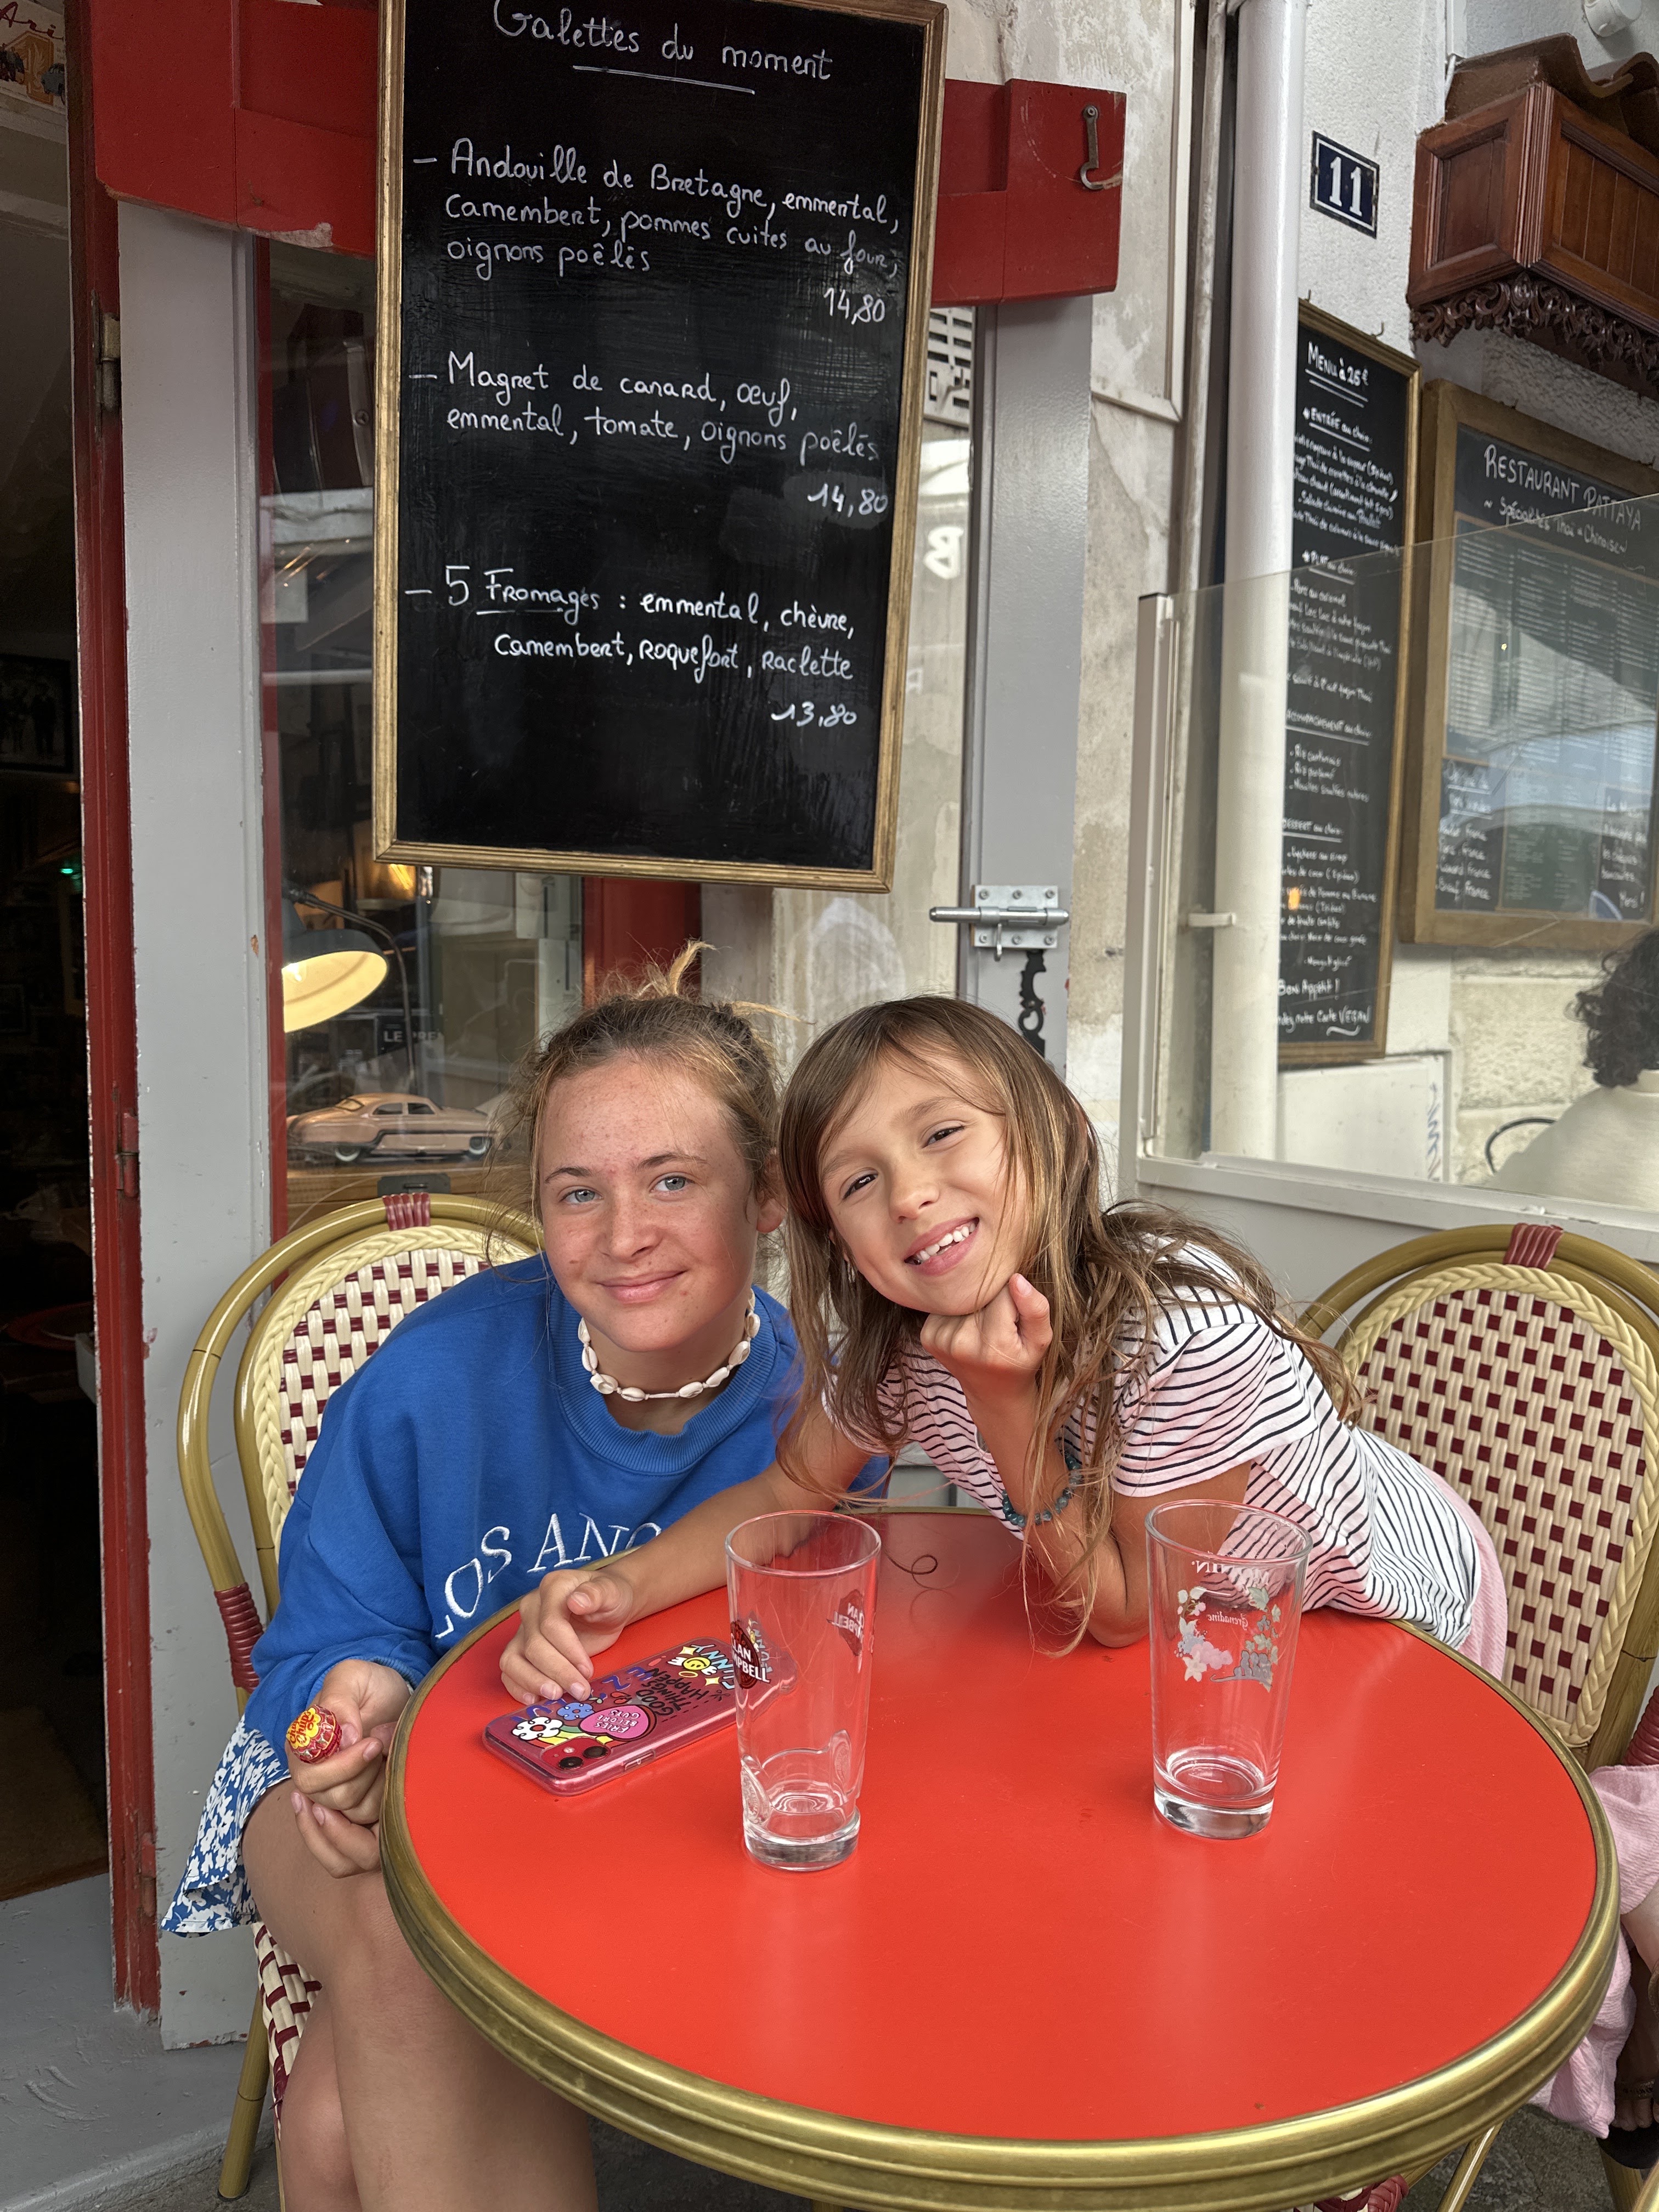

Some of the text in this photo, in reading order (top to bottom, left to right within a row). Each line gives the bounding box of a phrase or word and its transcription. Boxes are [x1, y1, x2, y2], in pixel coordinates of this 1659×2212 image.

[494, 0, 833, 80] Galettes du moment
[452, 138, 587, 183] Andouille
[603, 159, 633, 188] de
[782, 193, 898, 237] emmental,
[1330, 157, 1362, 217] 11
[445, 194, 610, 237] Camembert,
[617, 211, 710, 246] pommes
[726, 216, 787, 249] cuites
[804, 238, 831, 255] au
[448, 241, 544, 280] oignons
[823, 285, 885, 325] 14,80
[448, 351, 549, 410] Magret
[573, 364, 602, 391] de
[620, 373, 725, 411] canard,
[447, 401, 577, 444] emmental,
[584, 407, 690, 450] tomate,
[701, 414, 786, 464] oignons
[808, 483, 888, 517] 14,80
[445, 565, 470, 606] 5
[481, 568, 600, 625] Fromages
[640, 591, 769, 632] emmental,
[494, 631, 633, 665] Camembert,
[771, 701, 857, 727] 13,80
[609, 1709, 640, 1719] GUYS
[636, 1689, 674, 1716] GOOD
[641, 1680, 692, 1711] THINGS
[594, 1721, 630, 1734] FRIES
[596, 1714, 639, 1727] BEFORE
